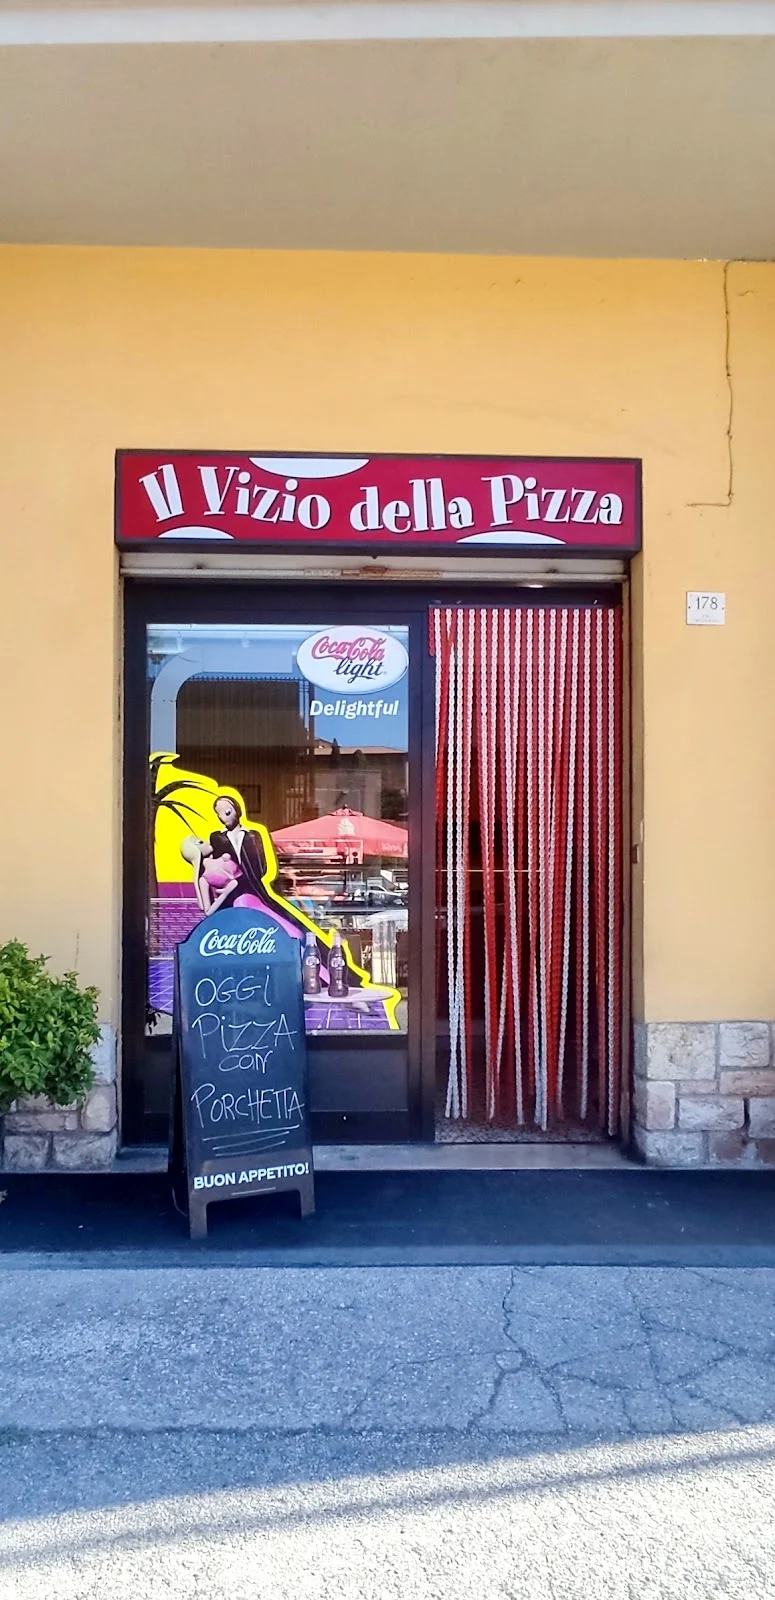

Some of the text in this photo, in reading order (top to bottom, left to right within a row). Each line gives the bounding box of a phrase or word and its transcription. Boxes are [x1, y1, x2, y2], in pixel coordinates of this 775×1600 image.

[138, 463, 623, 534] Il Vizio della Pizza
[696, 596, 718, 610] 178
[333, 656, 385, 684] light
[309, 699, 400, 720] Delightful
[199, 925, 279, 957] Coca-Cola
[190, 1082, 306, 1129] PORCHETTA
[193, 1161, 310, 1191] BUON APPETITO!
